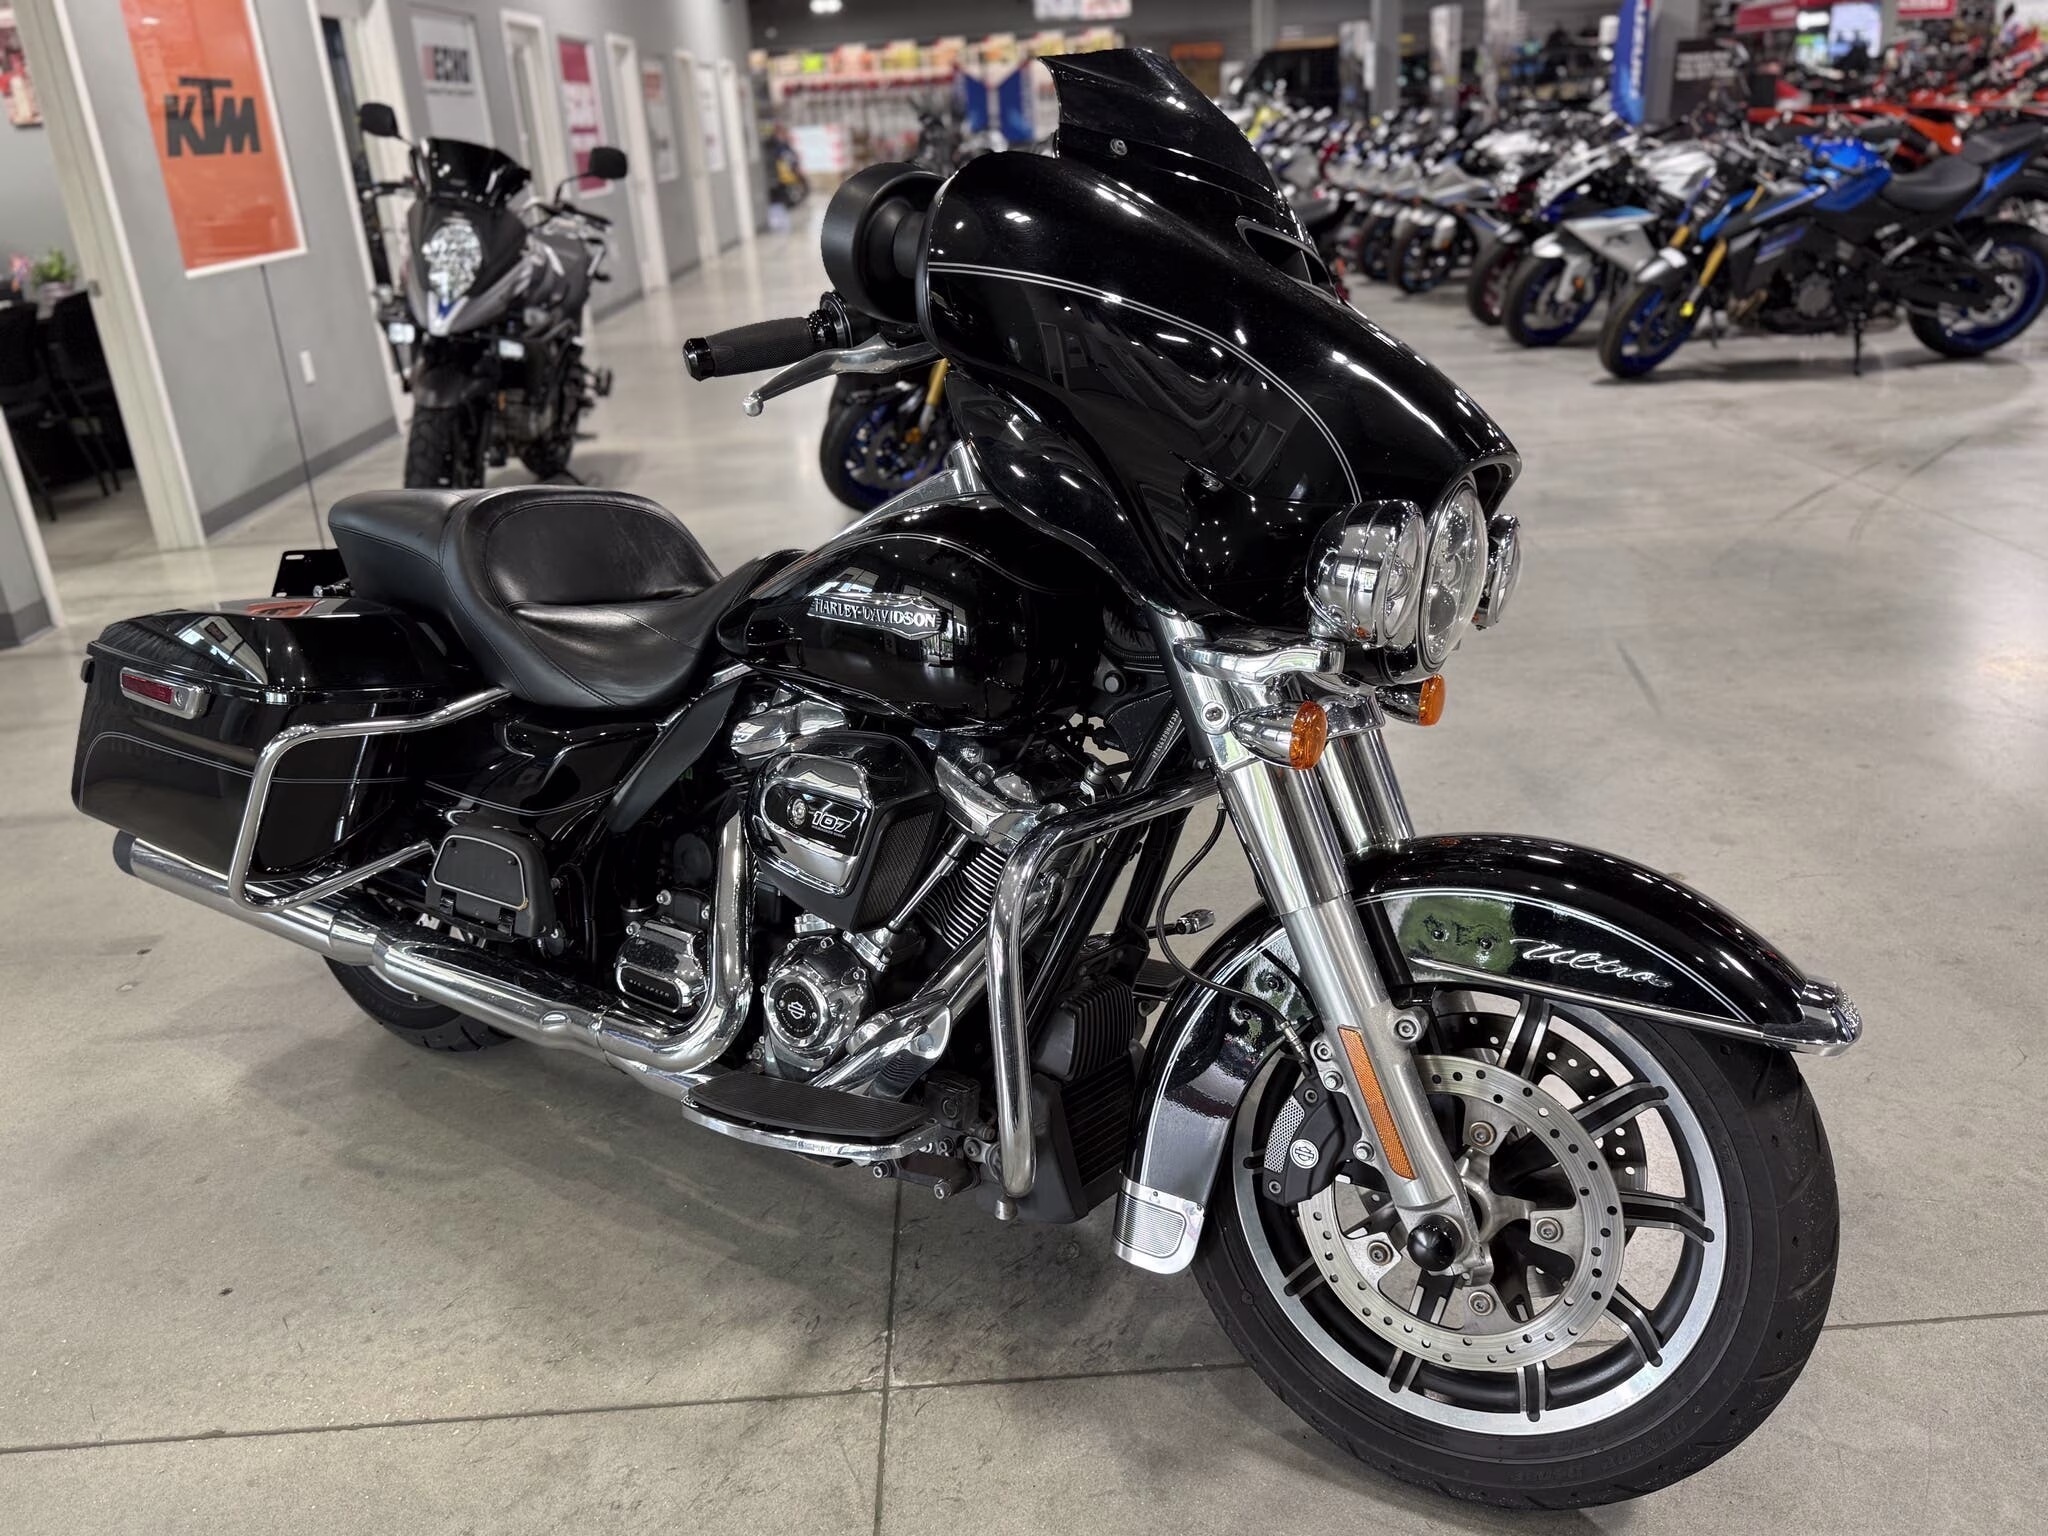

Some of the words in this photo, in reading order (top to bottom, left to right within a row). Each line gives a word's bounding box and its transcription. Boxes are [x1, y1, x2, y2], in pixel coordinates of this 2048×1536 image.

[164, 77, 262, 157] KTM
[814, 598, 936, 628] HARLEY-DAVIDSON
[811, 810, 852, 833] 107
[1509, 938, 1672, 989] Ultra
